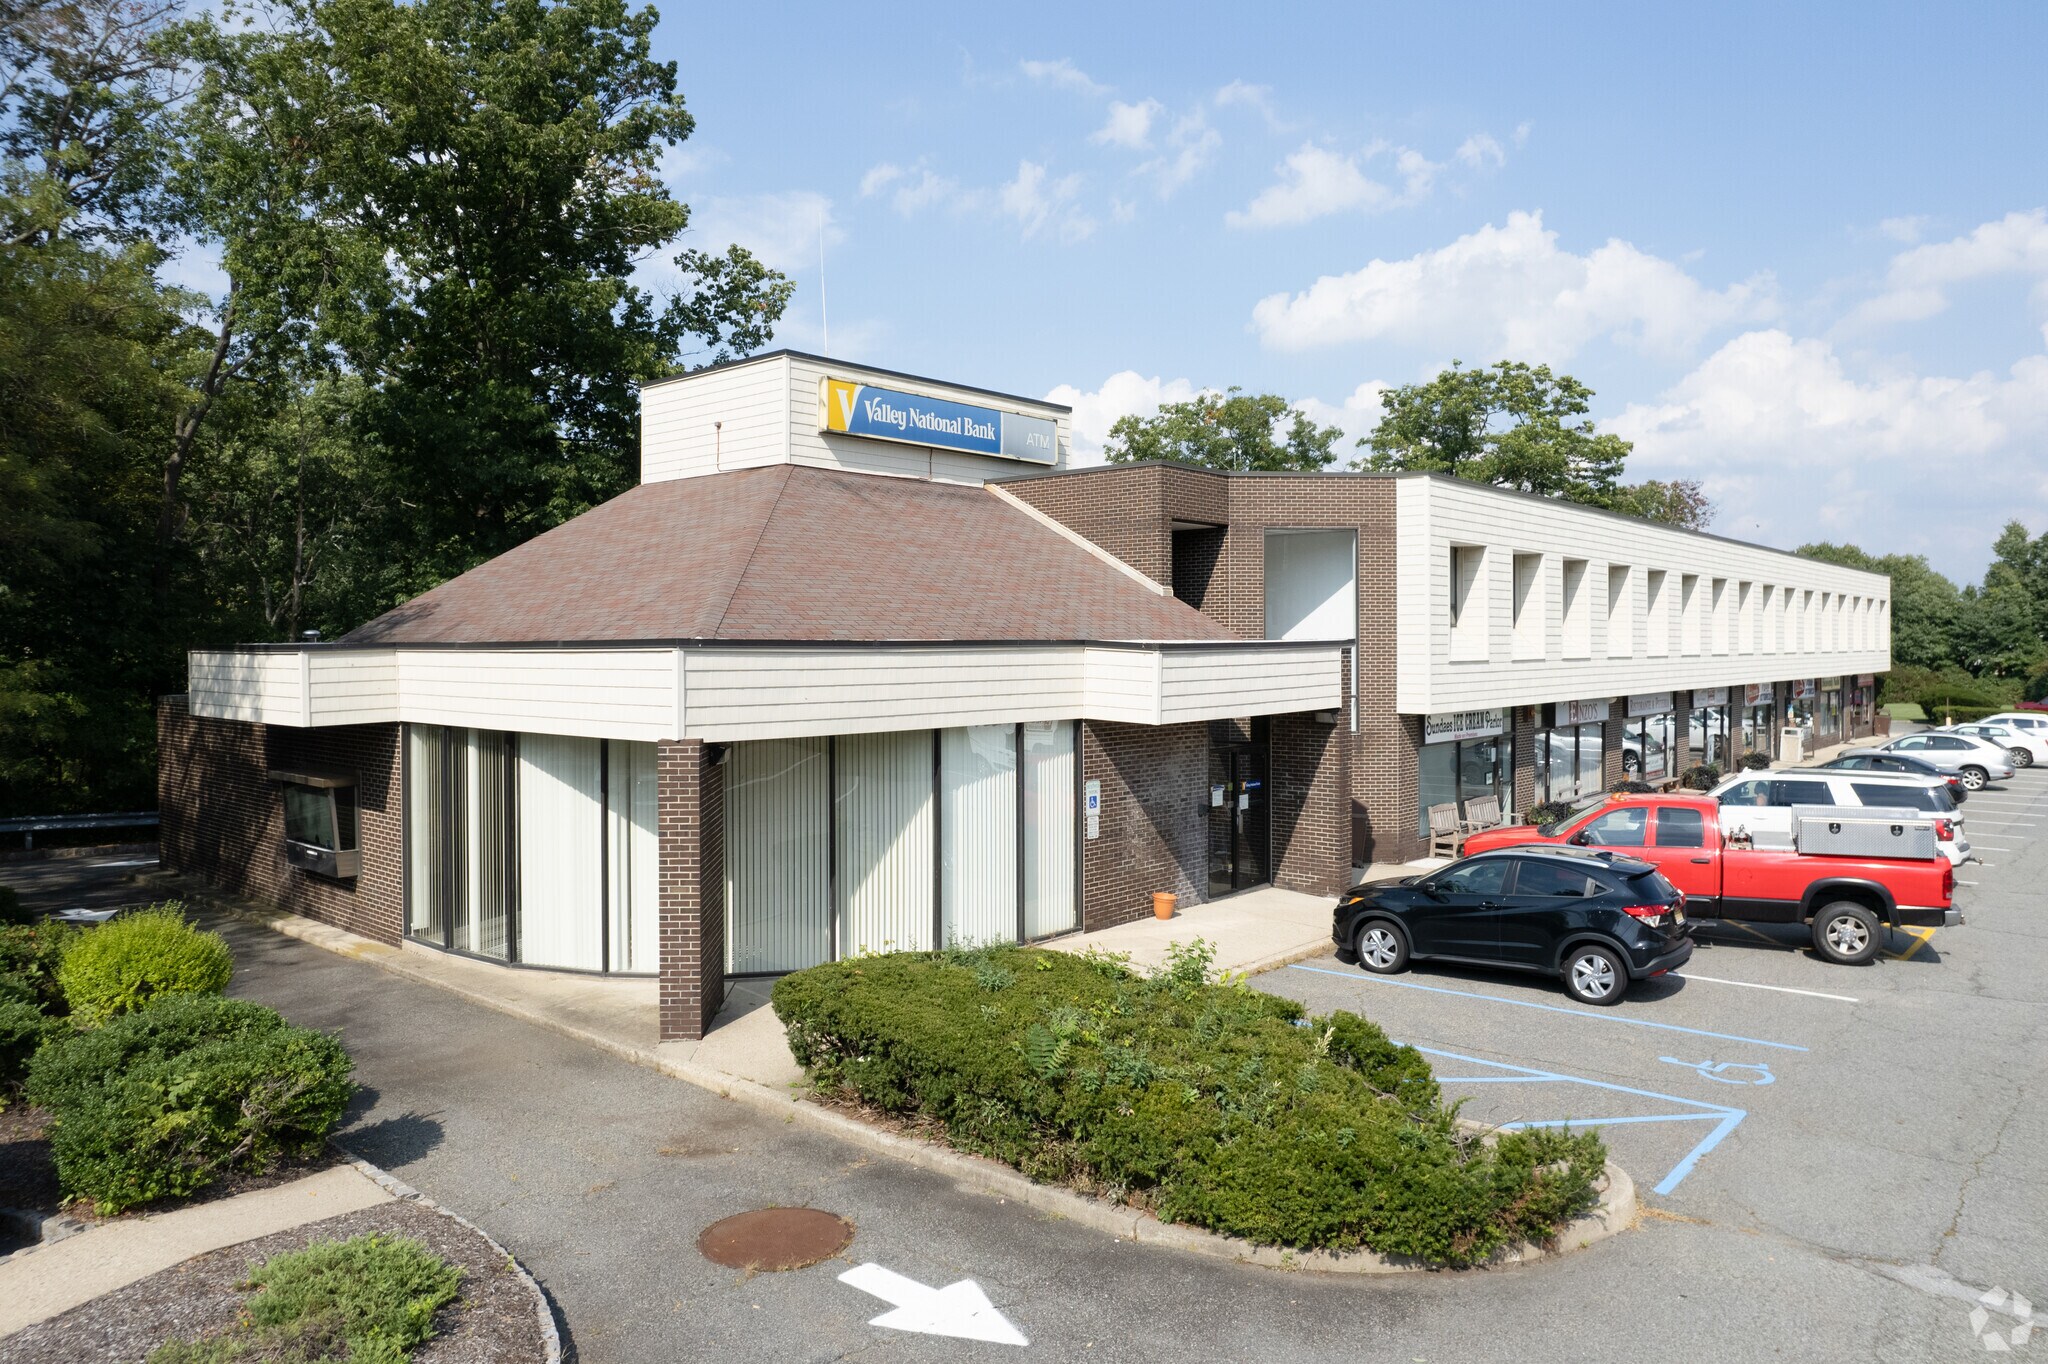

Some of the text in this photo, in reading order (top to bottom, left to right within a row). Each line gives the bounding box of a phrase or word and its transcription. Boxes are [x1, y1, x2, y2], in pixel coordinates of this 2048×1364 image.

[864, 397, 996, 441] Valley National Bank
[1026, 431, 1050, 450] ATM
[1453, 713, 1464, 732] ICE
[1465, 711, 1485, 731] CREAM
[1485, 711, 1503, 729] Parlor
